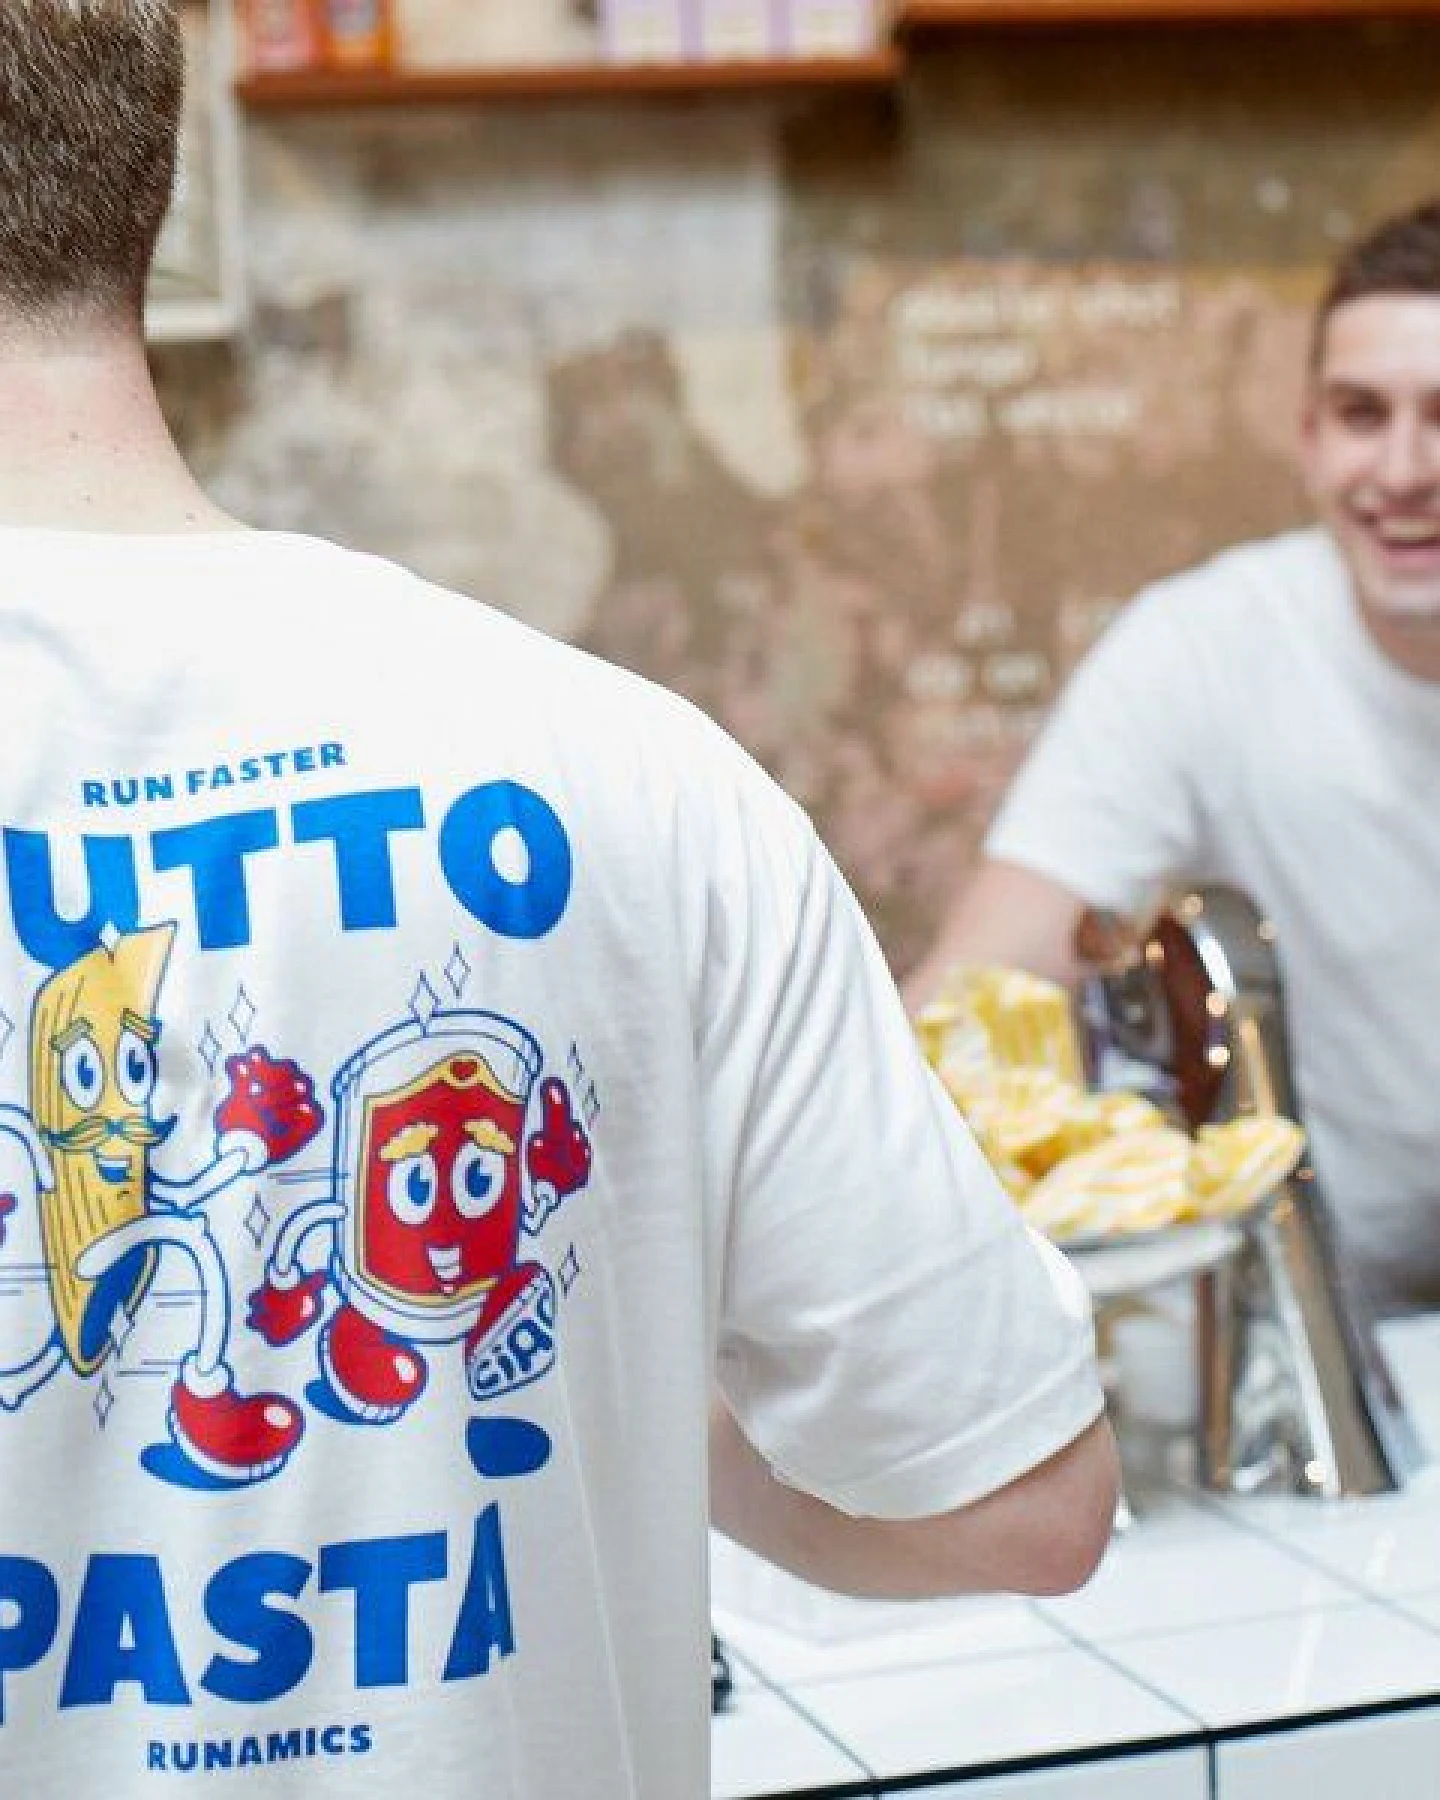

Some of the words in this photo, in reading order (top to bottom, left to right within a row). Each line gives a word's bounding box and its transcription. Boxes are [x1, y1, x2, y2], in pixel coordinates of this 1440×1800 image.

[83, 775, 174, 808] RUN
[187, 741, 348, 795] FASTER
[146, 1724, 373, 1772] RUNAMICS
